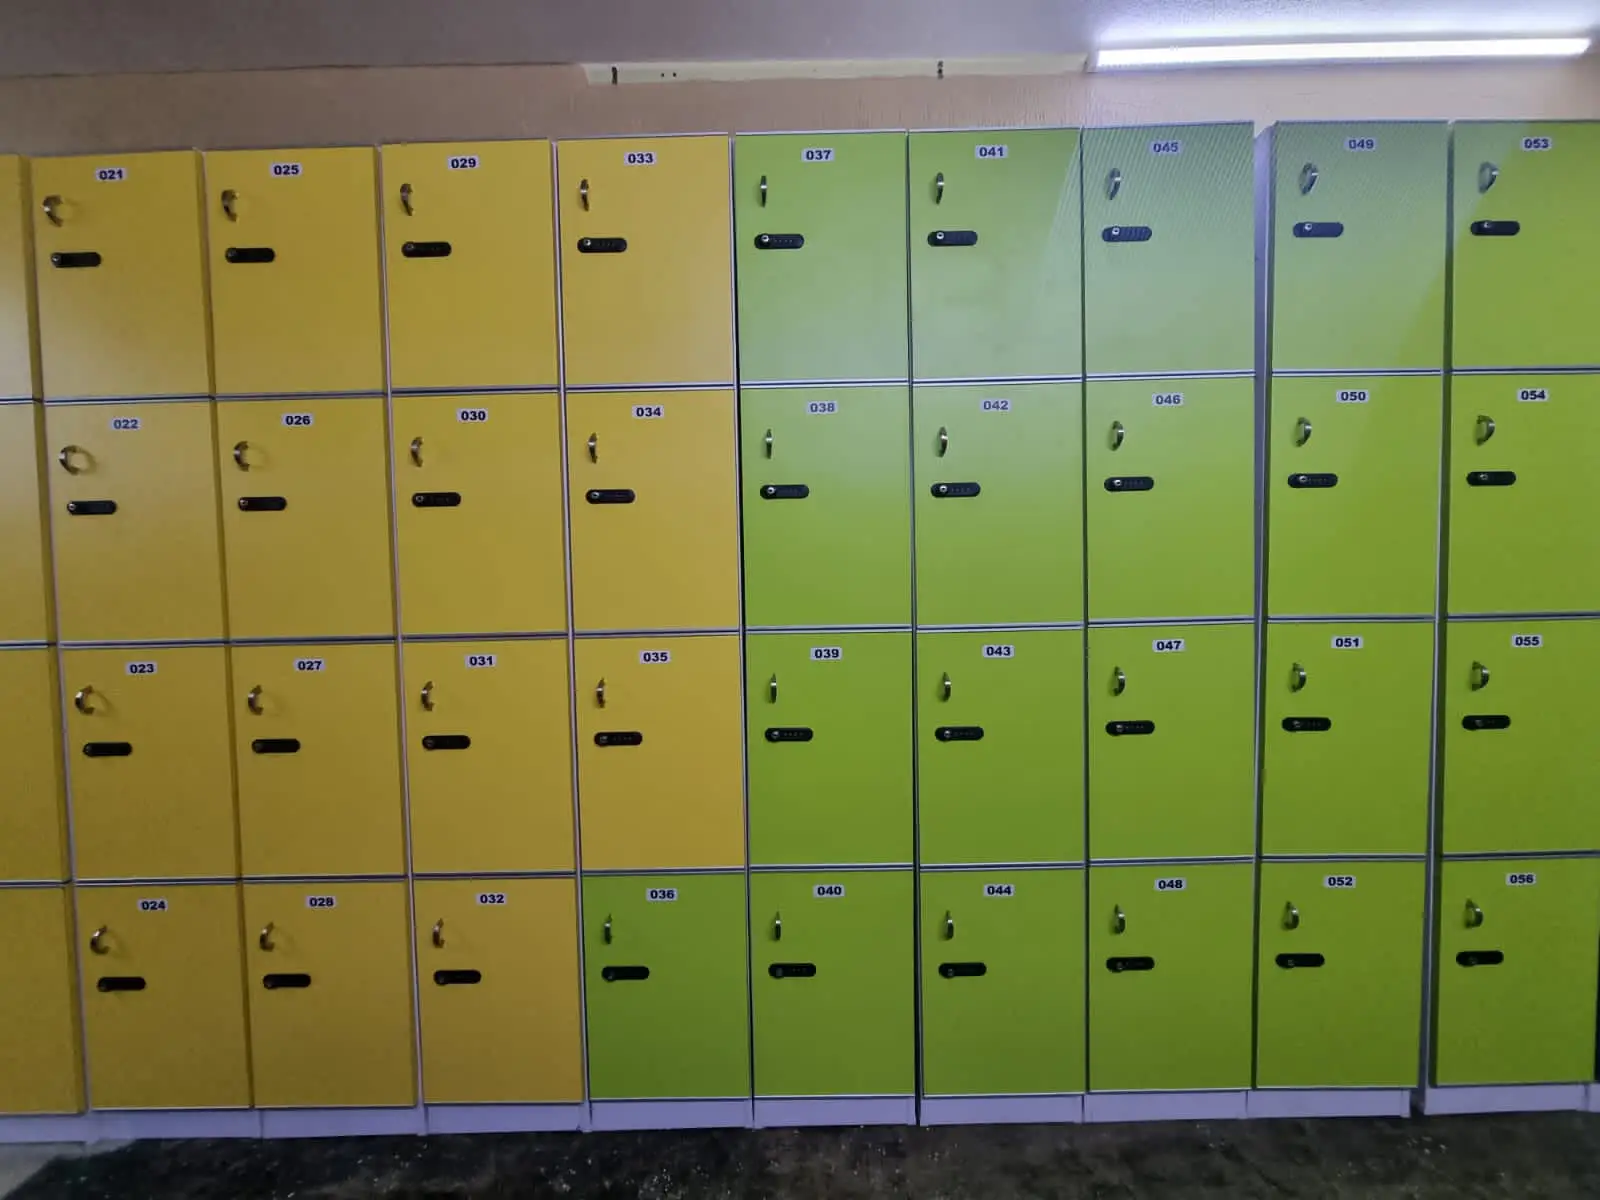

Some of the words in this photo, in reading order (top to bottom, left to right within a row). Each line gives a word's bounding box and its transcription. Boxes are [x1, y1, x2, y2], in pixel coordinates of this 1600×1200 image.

[1153, 141, 1179, 153] 045
[1348, 139, 1374, 150] 049
[1524, 138, 1549, 149] 053
[805, 149, 832, 161] 037
[979, 146, 1004, 157] 041
[451, 157, 477, 169] 029
[627, 152, 654, 164] 033
[98, 169, 123, 181] 021
[273, 164, 300, 176] 025
[1155, 394, 1181, 405] 046
[1340, 391, 1366, 402] 050
[1520, 389, 1546, 401] 054
[809, 402, 835, 413] 038
[983, 400, 1009, 411] 042
[460, 410, 486, 421] 030
[636, 407, 661, 417] 034
[113, 419, 139, 430] 022
[285, 415, 311, 426] 026
[1156, 640, 1182, 651] 047
[1335, 637, 1359, 648] 051
[1515, 636, 1540, 647] 055
[643, 651, 668, 663] 035
[814, 648, 840, 659] 039
[986, 646, 1011, 657] 043
[297, 660, 322, 671] 027
[469, 655, 493, 666] 031
[129, 663, 154, 674] 023
[1158, 879, 1183, 890] 048
[1327, 876, 1353, 887] 052
[1509, 874, 1534, 884] 056
[650, 889, 675, 900] 036
[817, 886, 842, 896] 040
[987, 885, 1012, 896] 044
[309, 897, 334, 907] 028
[479, 894, 505, 904] 032
[141, 900, 166, 911] 024
